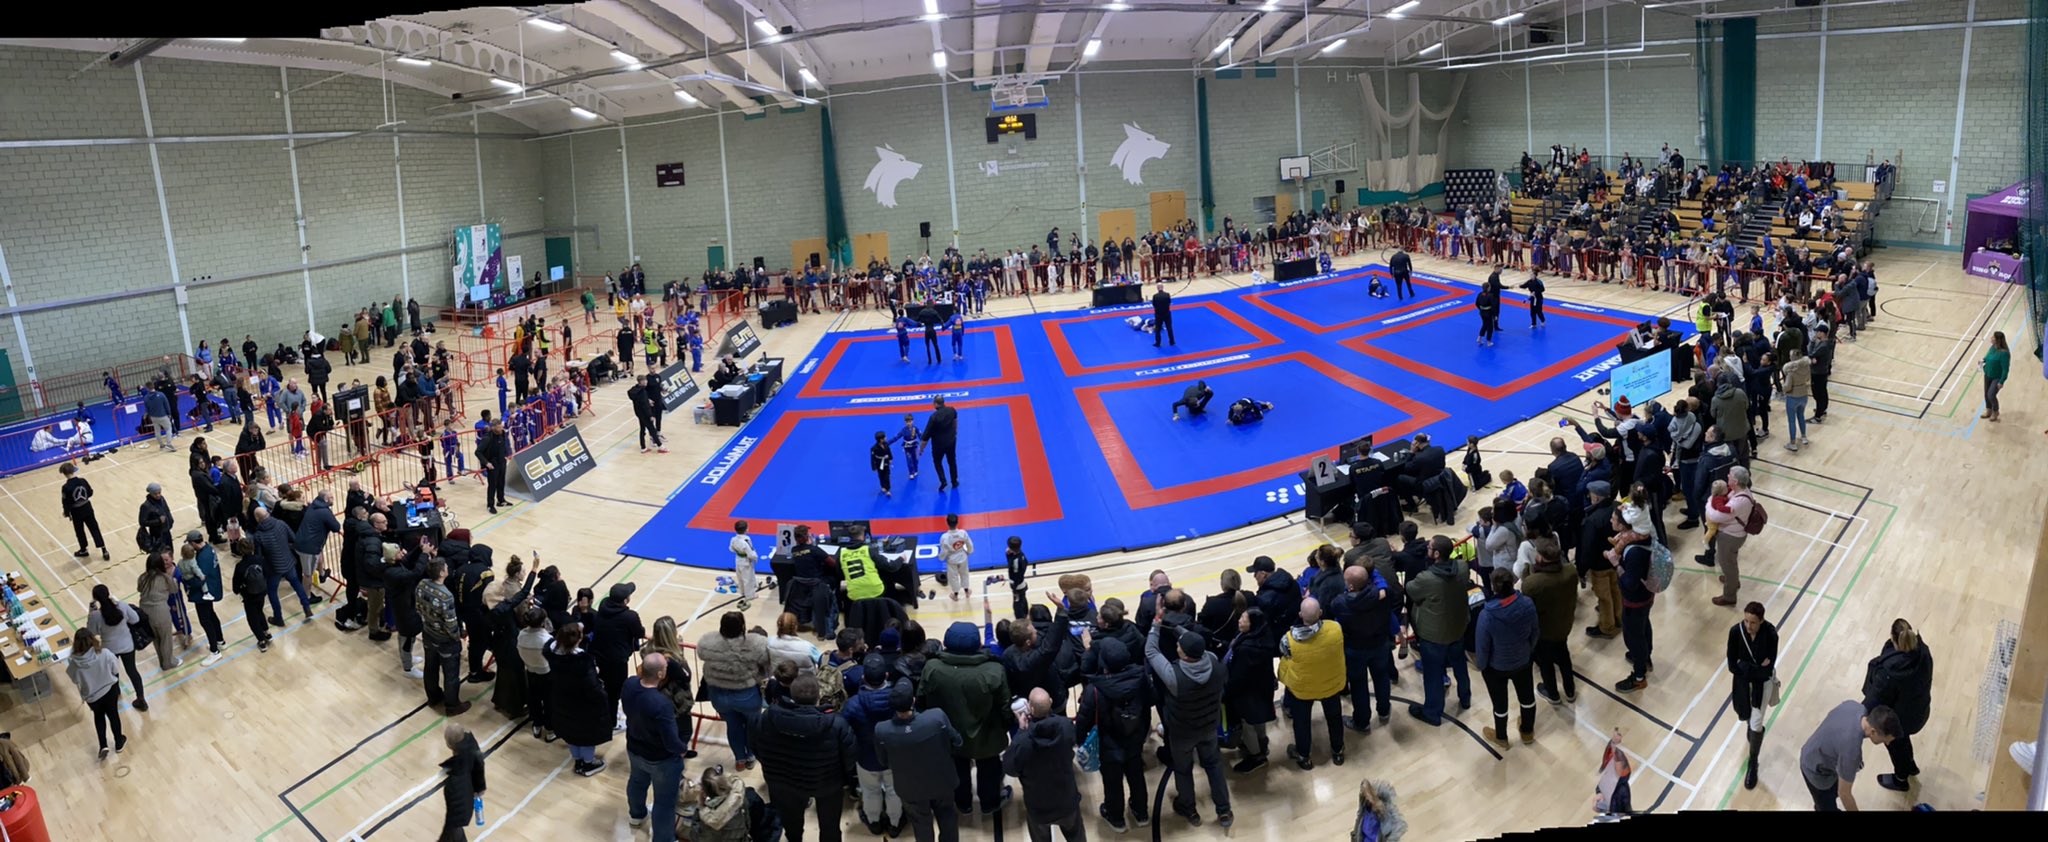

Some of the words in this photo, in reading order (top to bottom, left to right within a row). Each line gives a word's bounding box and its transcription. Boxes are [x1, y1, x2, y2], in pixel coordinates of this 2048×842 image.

[1570, 354, 1623, 382] AMUR
[524, 435, 585, 480] ELITE
[532, 474, 553, 491] BJJ
[552, 452, 590, 479] EVENTS
[700, 435, 759, 486] DOLLAMUR
[1318, 461, 1329, 478] 2
[782, 529, 792, 547] 3
[846, 558, 866, 579] 3
